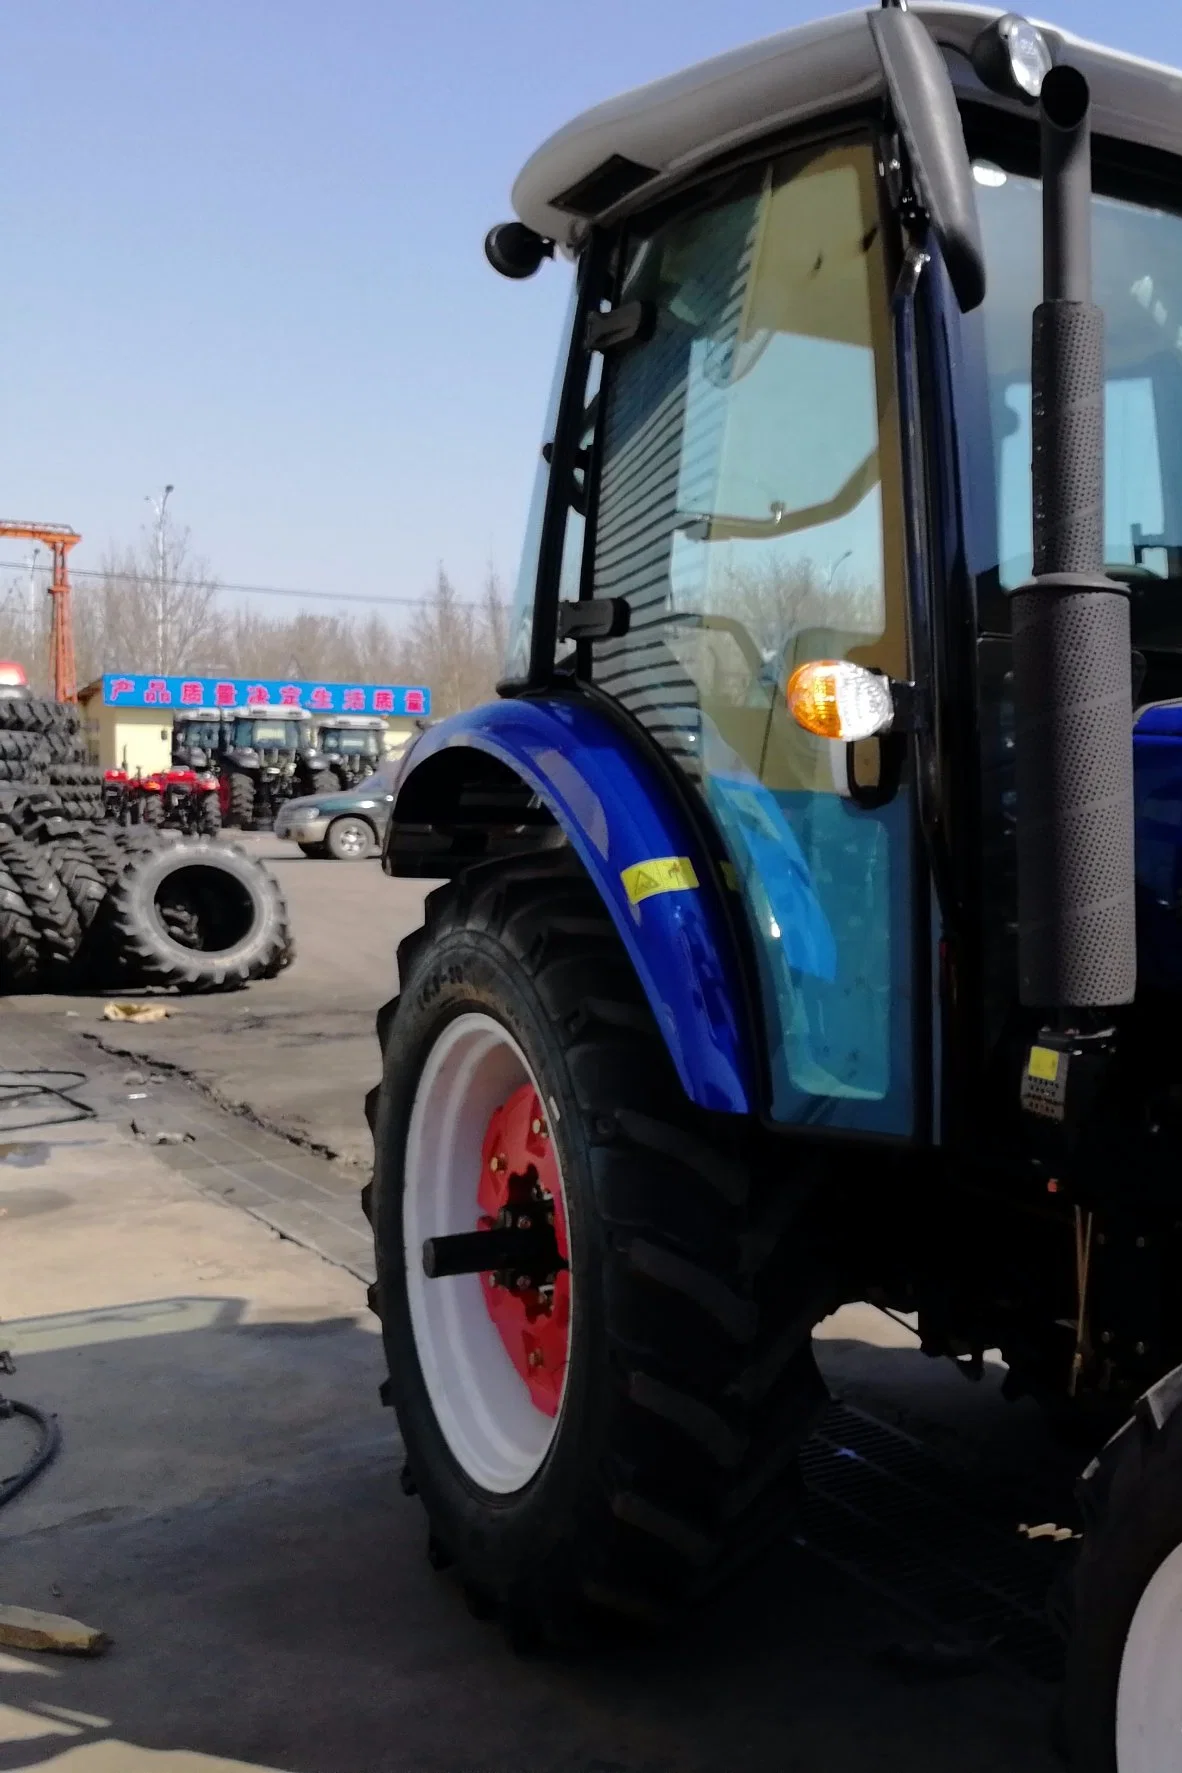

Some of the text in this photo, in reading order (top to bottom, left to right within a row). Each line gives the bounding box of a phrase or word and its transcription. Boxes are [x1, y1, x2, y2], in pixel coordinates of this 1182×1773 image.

[110, 679, 425, 712] 产品质量决定生活质量
